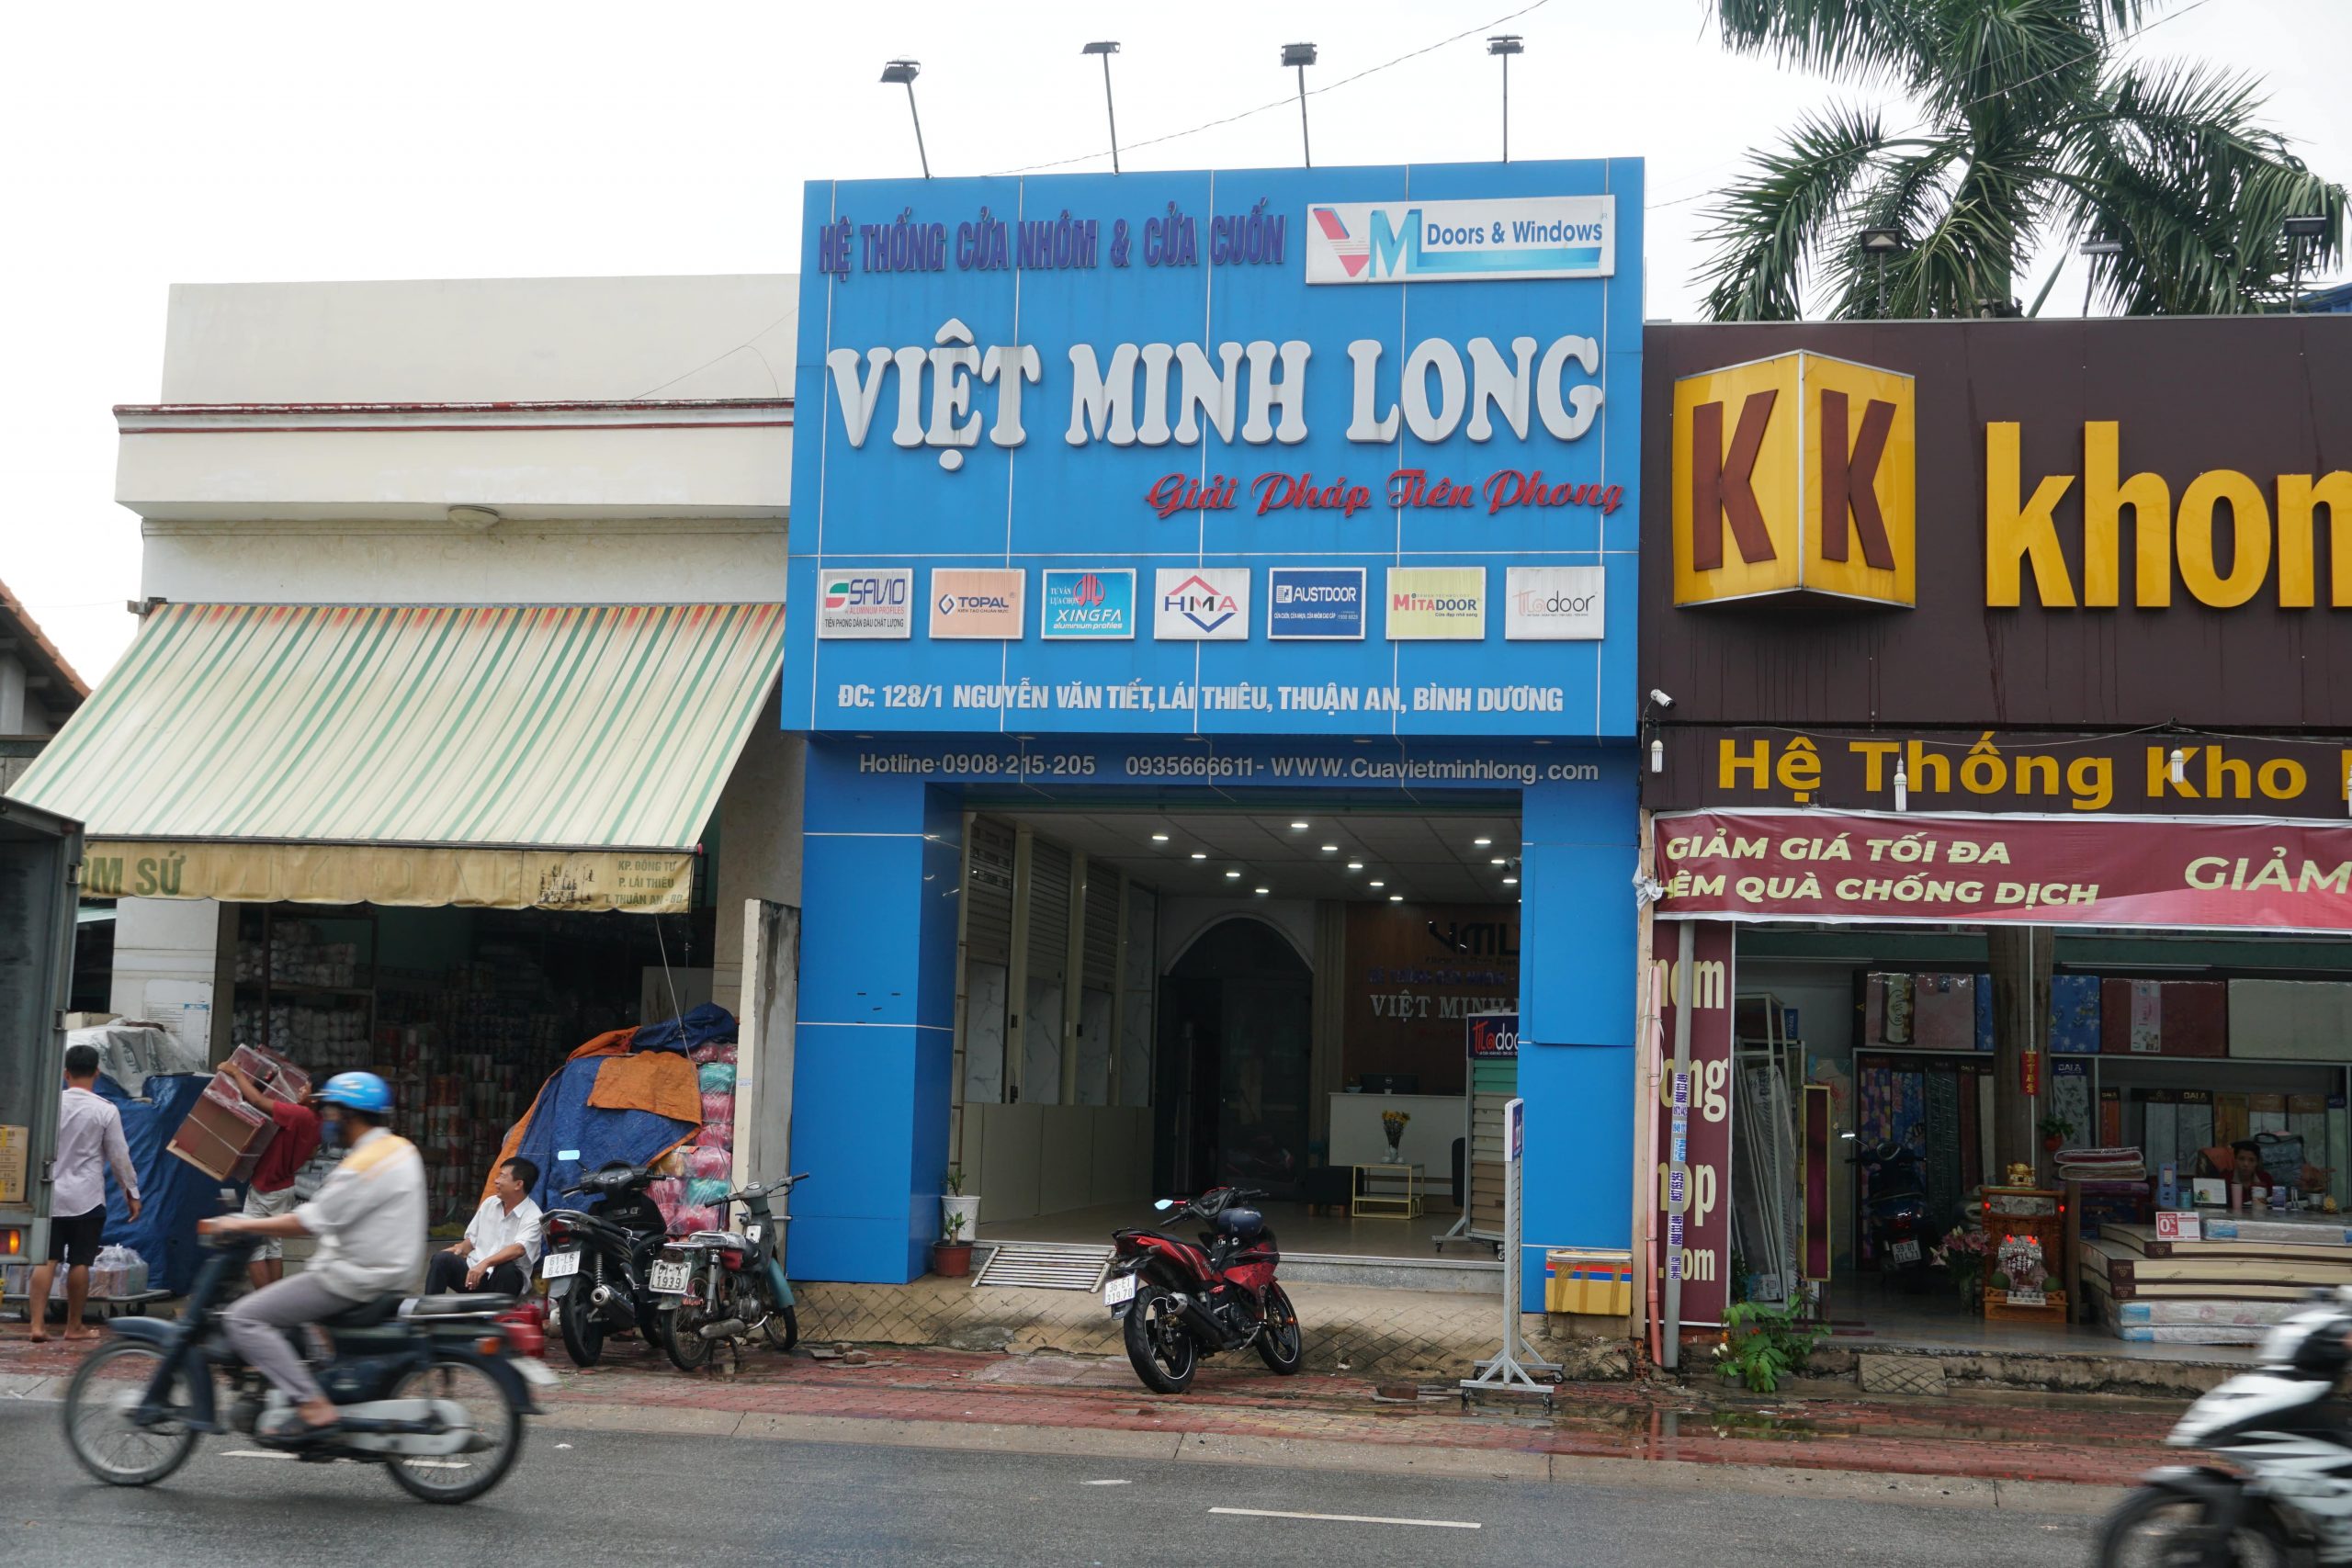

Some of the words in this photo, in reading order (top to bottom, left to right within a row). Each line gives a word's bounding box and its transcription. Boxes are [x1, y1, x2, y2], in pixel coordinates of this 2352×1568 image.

[820, 215, 853, 281] HỆ
[860, 207, 946, 273] THỐNG
[956, 206, 1009, 270] CỬA
[1016, 209, 1098, 268] NHÔM
[1110, 219, 1131, 267] &
[1143, 200, 1197, 266] CỬA
[1209, 197, 1286, 265] CUỐN
[1427, 223, 1485, 245] Doors
[1491, 221, 1505, 243] &
[1512, 220, 1602, 243] Windows
[827, 318, 1041, 471] VIỆT
[1065, 341, 1311, 446] MINH
[1346, 334, 1603, 444] LONG
[1145, 472, 1238, 519] Giải
[1251, 471, 1372, 518] Pháp
[1386, 468, 1476, 510] Tiên
[1483, 468, 1625, 515] Phong
[849, 578, 905, 605] SAVIO
[957, 597, 1010, 608] TOPAL
[1165, 596, 1238, 612] HMA
[1293, 587, 1357, 602] AUSTDOOR
[878, 606, 905, 615] PROFILES
[1056, 609, 1122, 622] XINGFA
[838, 684, 875, 708] ĐC:
[883, 684, 943, 708] 128/1
[953, 677, 1048, 709] NGUYỄN
[1057, 681, 1102, 709] VĂN
[1158, 681, 1194, 709] LÁI
[1201, 682, 1272, 713] THIÊU,
[1278, 682, 1359, 716] THUẬN
[1364, 687, 1407, 714] AN,
[1413, 682, 1471, 711] BÌNH
[1477, 684, 1563, 712] DƯƠNG
[1718, 736, 1822, 803] Hệ
[1849, 731, 2113, 810] Thống
[2147, 745, 2307, 799] Kho
[1666, 829, 1770, 860] GIẢM
[1780, 832, 1851, 861] GIÁ
[1866, 831, 1937, 863] TỐI
[1947, 840, 2011, 864] ĐA
[135, 851, 187, 896] SỨ
[2185, 846, 2352, 894] GIẢM
[1736, 872, 1823, 903] QUÀ
[1835, 873, 1984, 904] CHỐNG
[1994, 882, 2099, 911] DỊCH
[1370, 988, 1431, 1022] VIỆT
[657, 1275, 682, 1289] 1939
